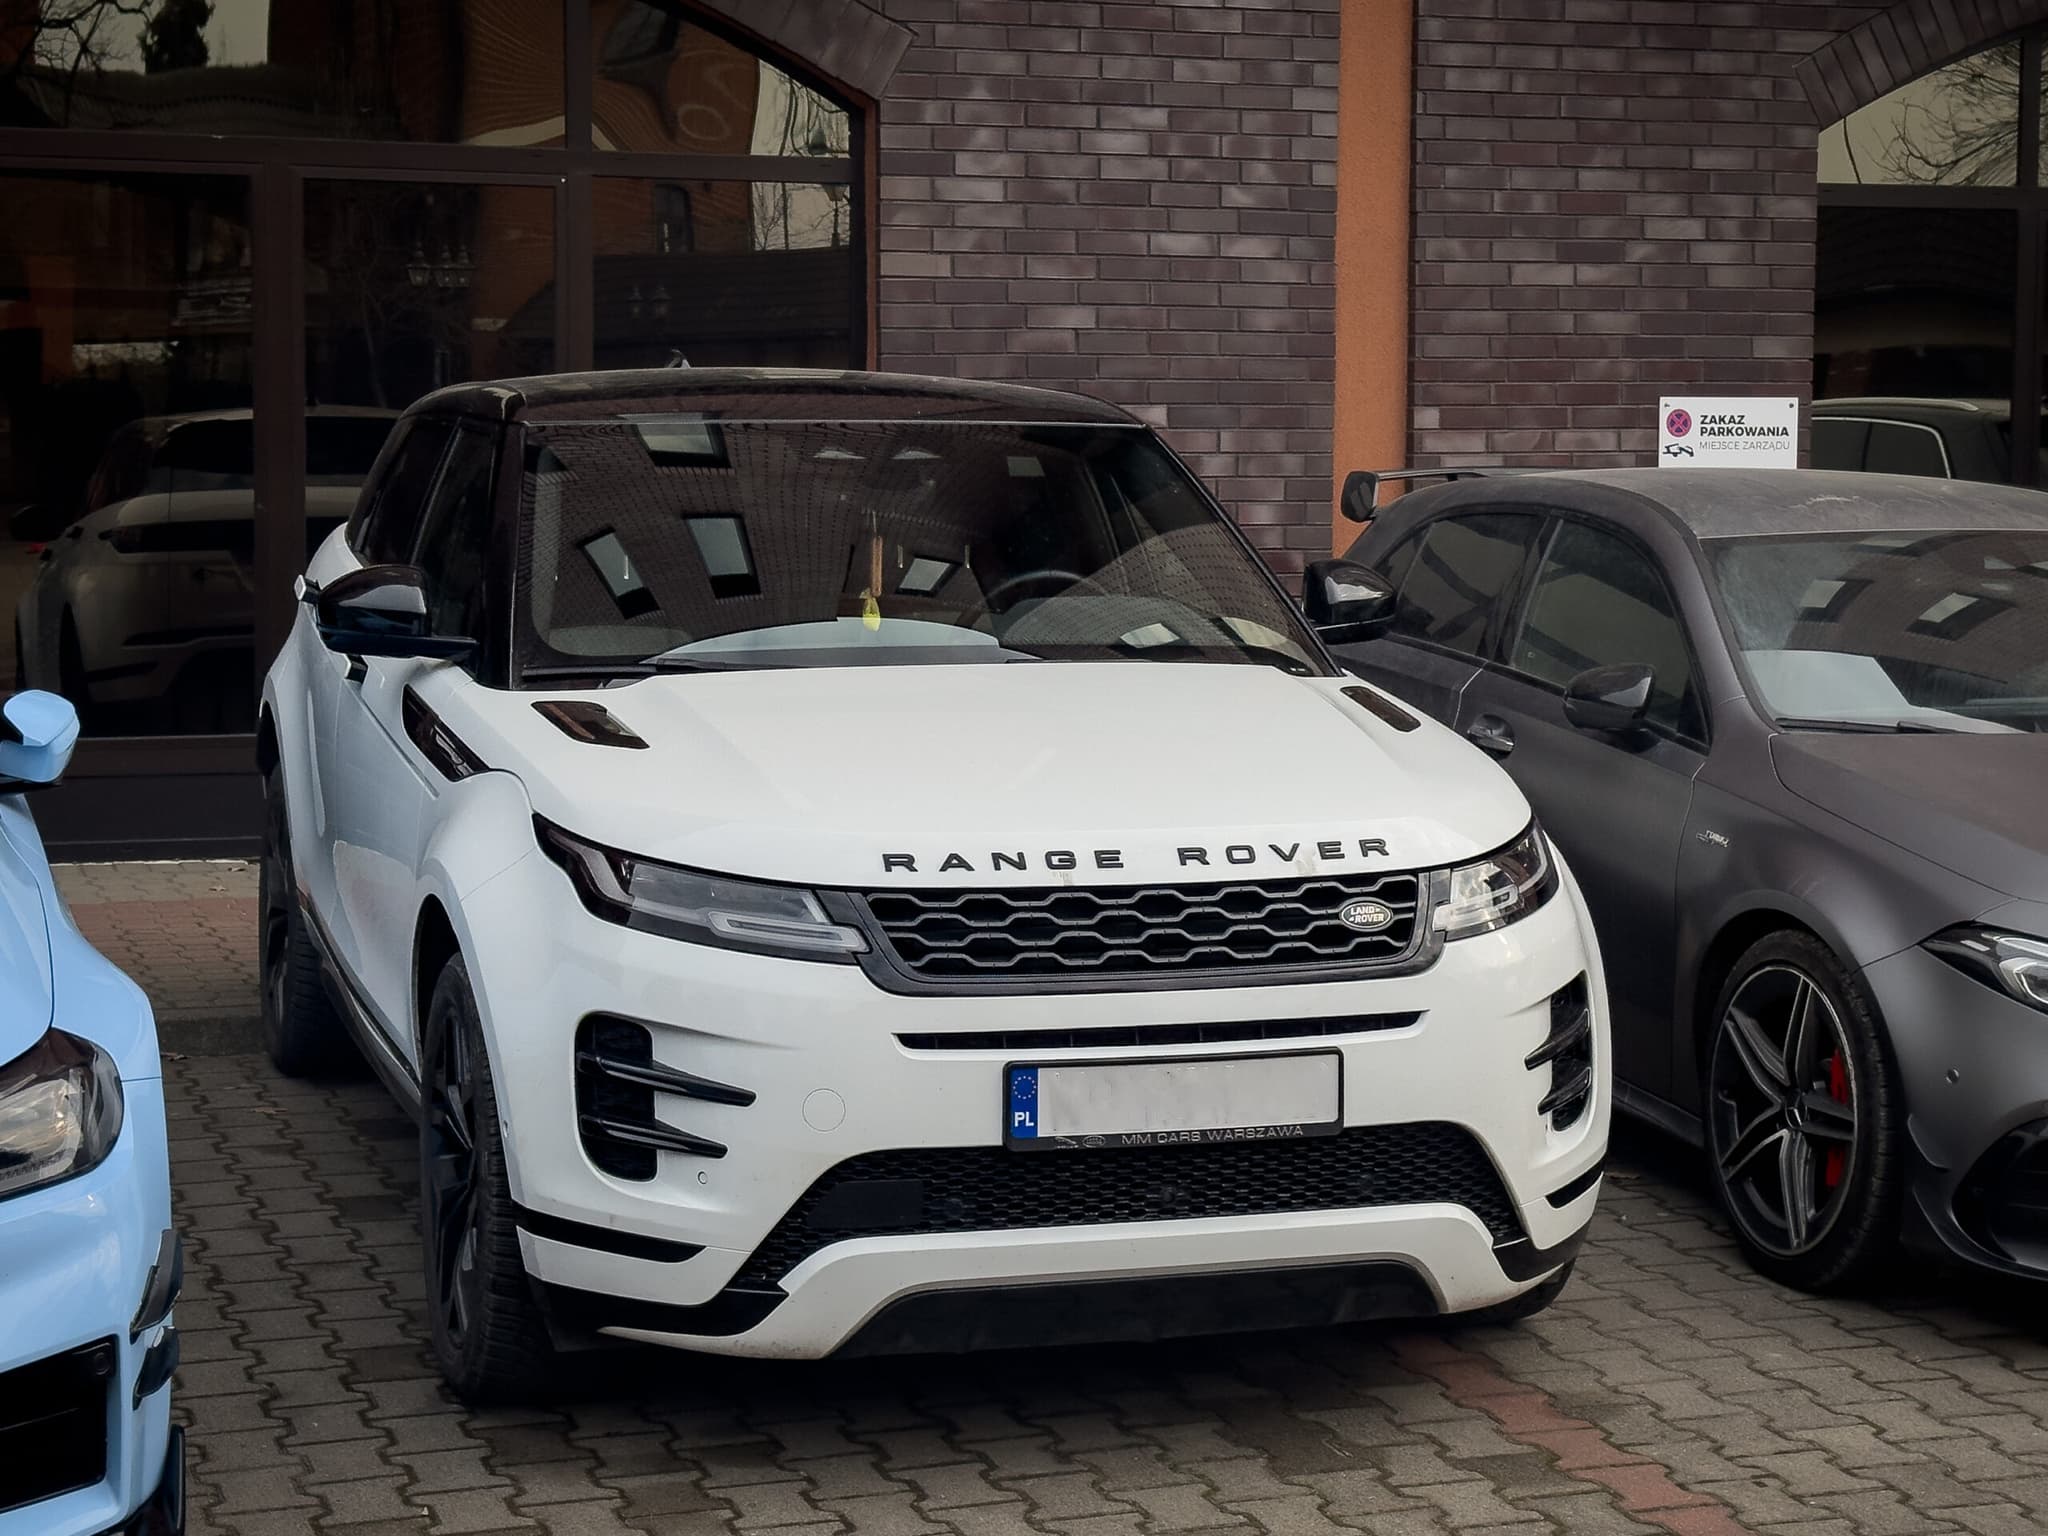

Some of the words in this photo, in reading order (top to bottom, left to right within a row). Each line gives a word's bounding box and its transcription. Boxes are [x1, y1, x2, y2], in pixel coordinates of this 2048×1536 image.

[1700, 414, 1745, 425] ZAKAZ
[1700, 426, 1790, 437] PARKOWANIA
[1699, 440, 1740, 450] MIEJSCE
[1742, 440, 1790, 451] ZARZĄDU
[881, 849, 1124, 873] RANGE
[1176, 837, 1390, 867] ROVER
[1350, 905, 1375, 915] LAND
[1354, 913, 1385, 924] ROVER
[1014, 1111, 1034, 1127] PL
[1121, 1133, 1152, 1145] MM
[1157, 1131, 1201, 1144] CARS
[1207, 1125, 1304, 1141] WARSZAWA
